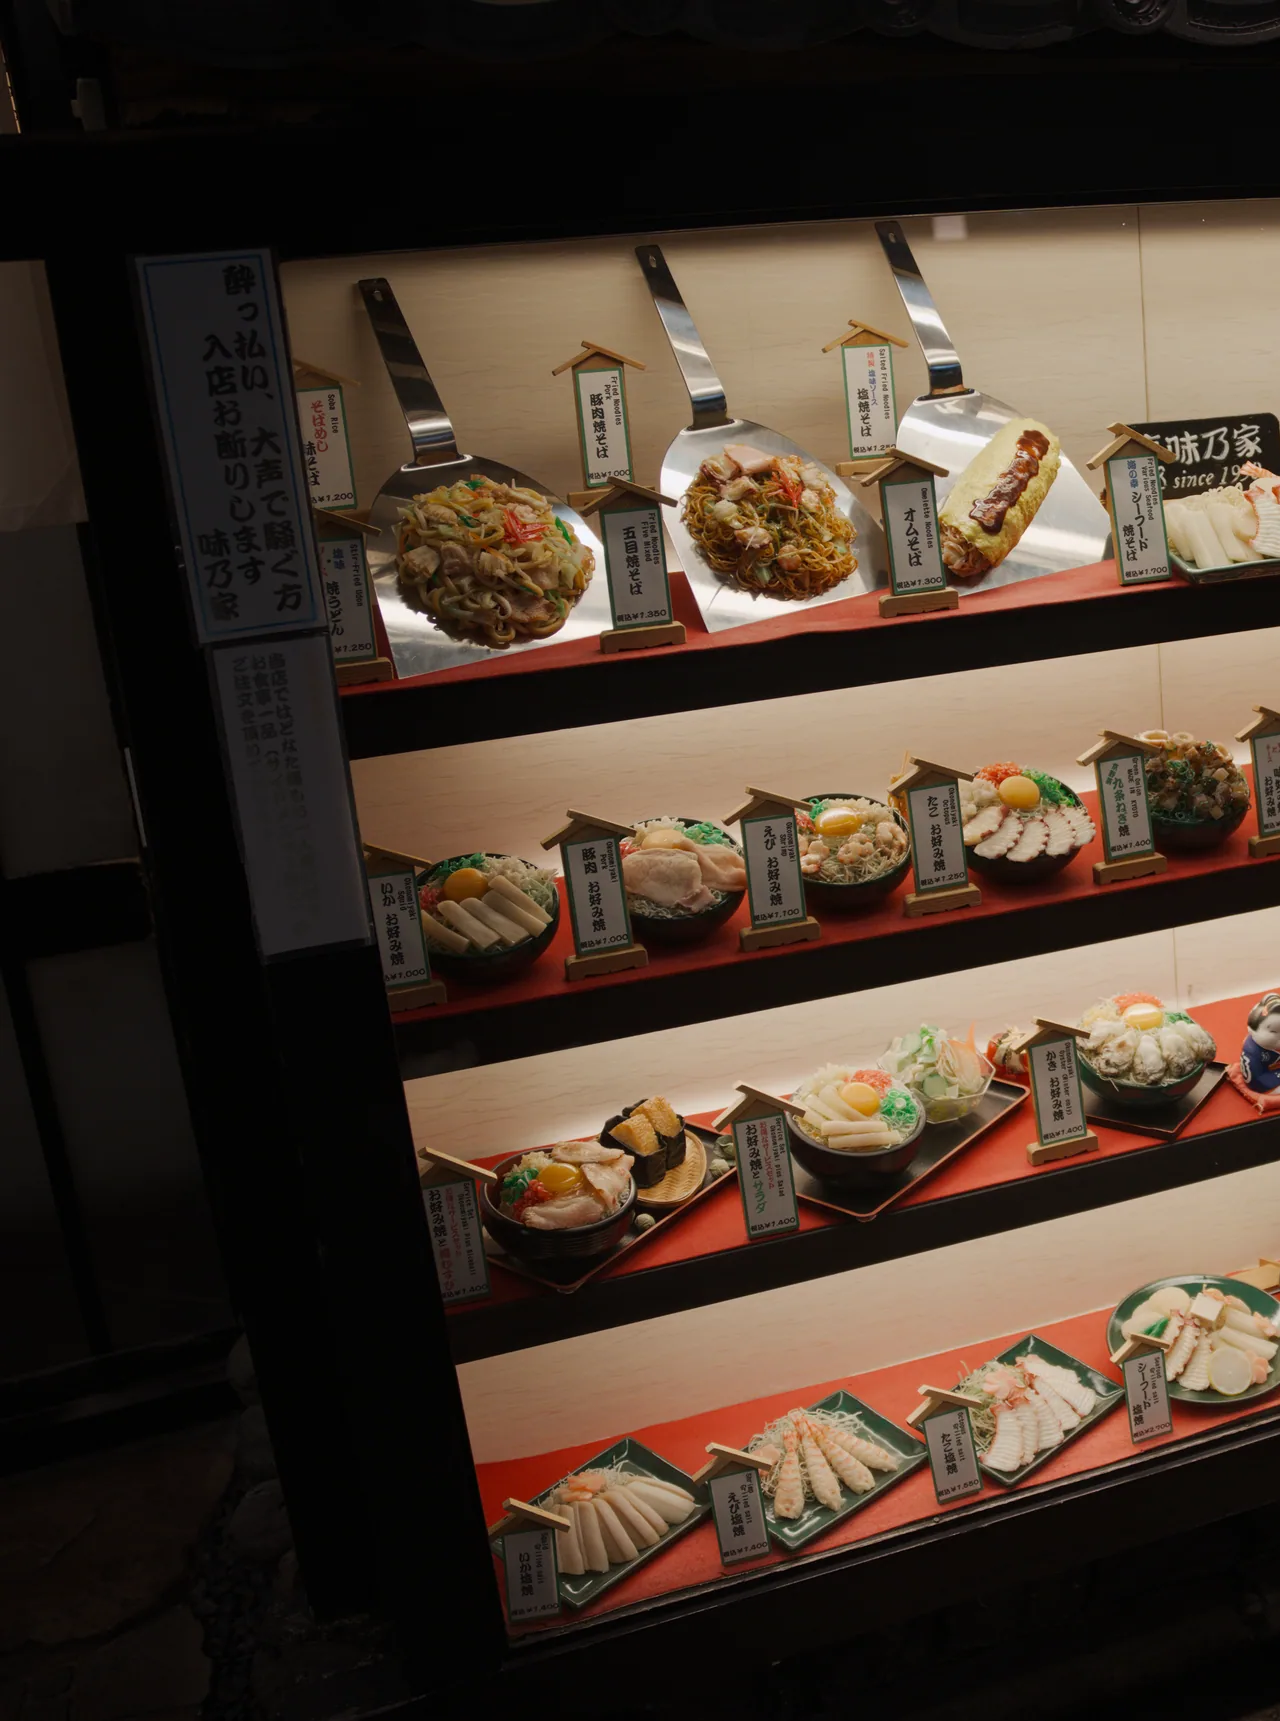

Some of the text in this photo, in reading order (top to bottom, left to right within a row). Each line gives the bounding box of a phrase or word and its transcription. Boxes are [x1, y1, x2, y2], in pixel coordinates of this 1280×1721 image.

[328, 394, 336, 411] Soba
[604, 384, 612, 400] Pork
[611, 376, 622, 426] Fried Noodles
[857, 388, 872, 438] 塩焼そば
[882, 394, 890, 419] Noodles
[311, 400, 329, 453] そばめし
[590, 393, 609, 459] 豚肉焼そば
[202, 333, 266, 586] 入店お断りします
[1172, 469, 1215, 489] since
[1142, 466, 1154, 521] Various Seafood
[1151, 479, 1159, 505] Noodles
[649, 512, 657, 533] Fried
[904, 508, 923, 567] オムそば
[921, 487, 933, 548] Omelette Noodles
[1131, 491, 1149, 551] シーフード
[623, 526, 643, 595] 五目焼そば
[641, 521, 652, 563] Five Mixed
[1122, 524, 1138, 562] 焼そば
[196, 529, 241, 622] 味乃家
[948, 787, 958, 828] Okonomiyaki
[1112, 777, 1130, 837] 九条ねぎ焼
[1131, 799, 1139, 818] KYOTO
[1264, 776, 1276, 818] お好み焼
[786, 821, 796, 863] Okonomiyaki
[927, 796, 946, 873] たこ お好み焼
[600, 854, 608, 870] Pork
[606, 841, 618, 883] Okonomiyaki
[764, 826, 783, 907] えび お好み焼
[404, 877, 417, 921] Okonomiyaki
[582, 847, 606, 932] 豚肉 お好み焼
[381, 882, 405, 966] いか お好み焼
[1065, 1042, 1075, 1078] Okonomiyaki
[1046, 1050, 1064, 1122] かき お好み焼
[770, 1125, 780, 1162] Okonomiyaki
[778, 1143, 786, 1155] Set
[1138, 1362, 1152, 1410] シーフード
[1150, 1367, 1158, 1390] Grilled
[1154, 1356, 1162, 1379] Seafood
[957, 1411, 967, 1435] Octopus
[1132, 1404, 1144, 1426] 塩焼
[941, 1432, 958, 1476] たこ塩焼
[953, 1423, 966, 1462] Grilled salt
[728, 1492, 746, 1538] えび塩焼
[519, 1552, 534, 1597] いか塩焼
